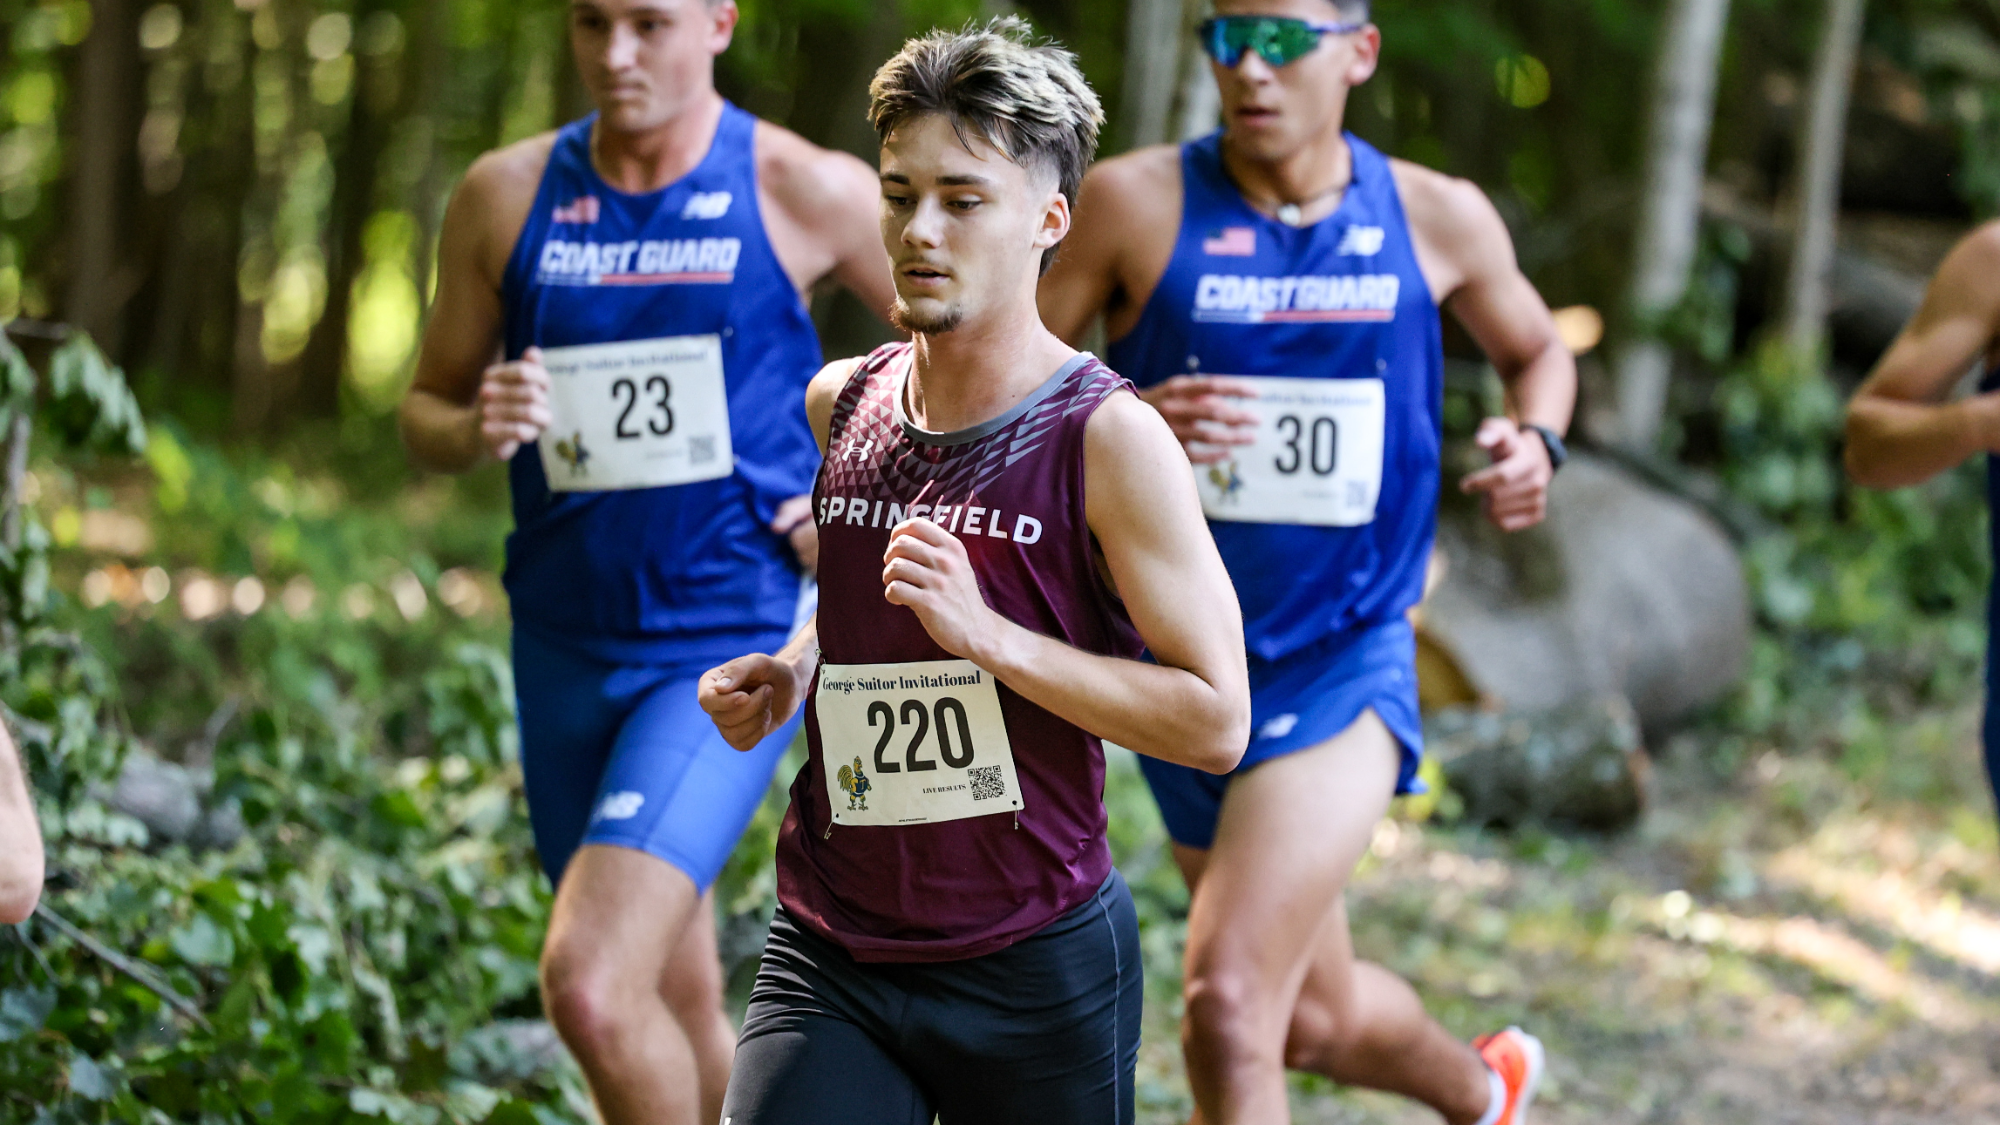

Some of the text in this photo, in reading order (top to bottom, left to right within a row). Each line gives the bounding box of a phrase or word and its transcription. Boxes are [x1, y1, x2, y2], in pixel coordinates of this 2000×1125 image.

[539, 237, 742, 275] COAST GUARD
[1195, 273, 1400, 311] COAST GUARD
[611, 374, 675, 440] 23
[1274, 414, 1338, 476] 30
[819, 496, 1043, 545] SPRINGFIELD
[822, 670, 981, 695] George Suitor Invitational
[867, 696, 975, 774] 220
[937, 784, 967, 793] RESULTS
